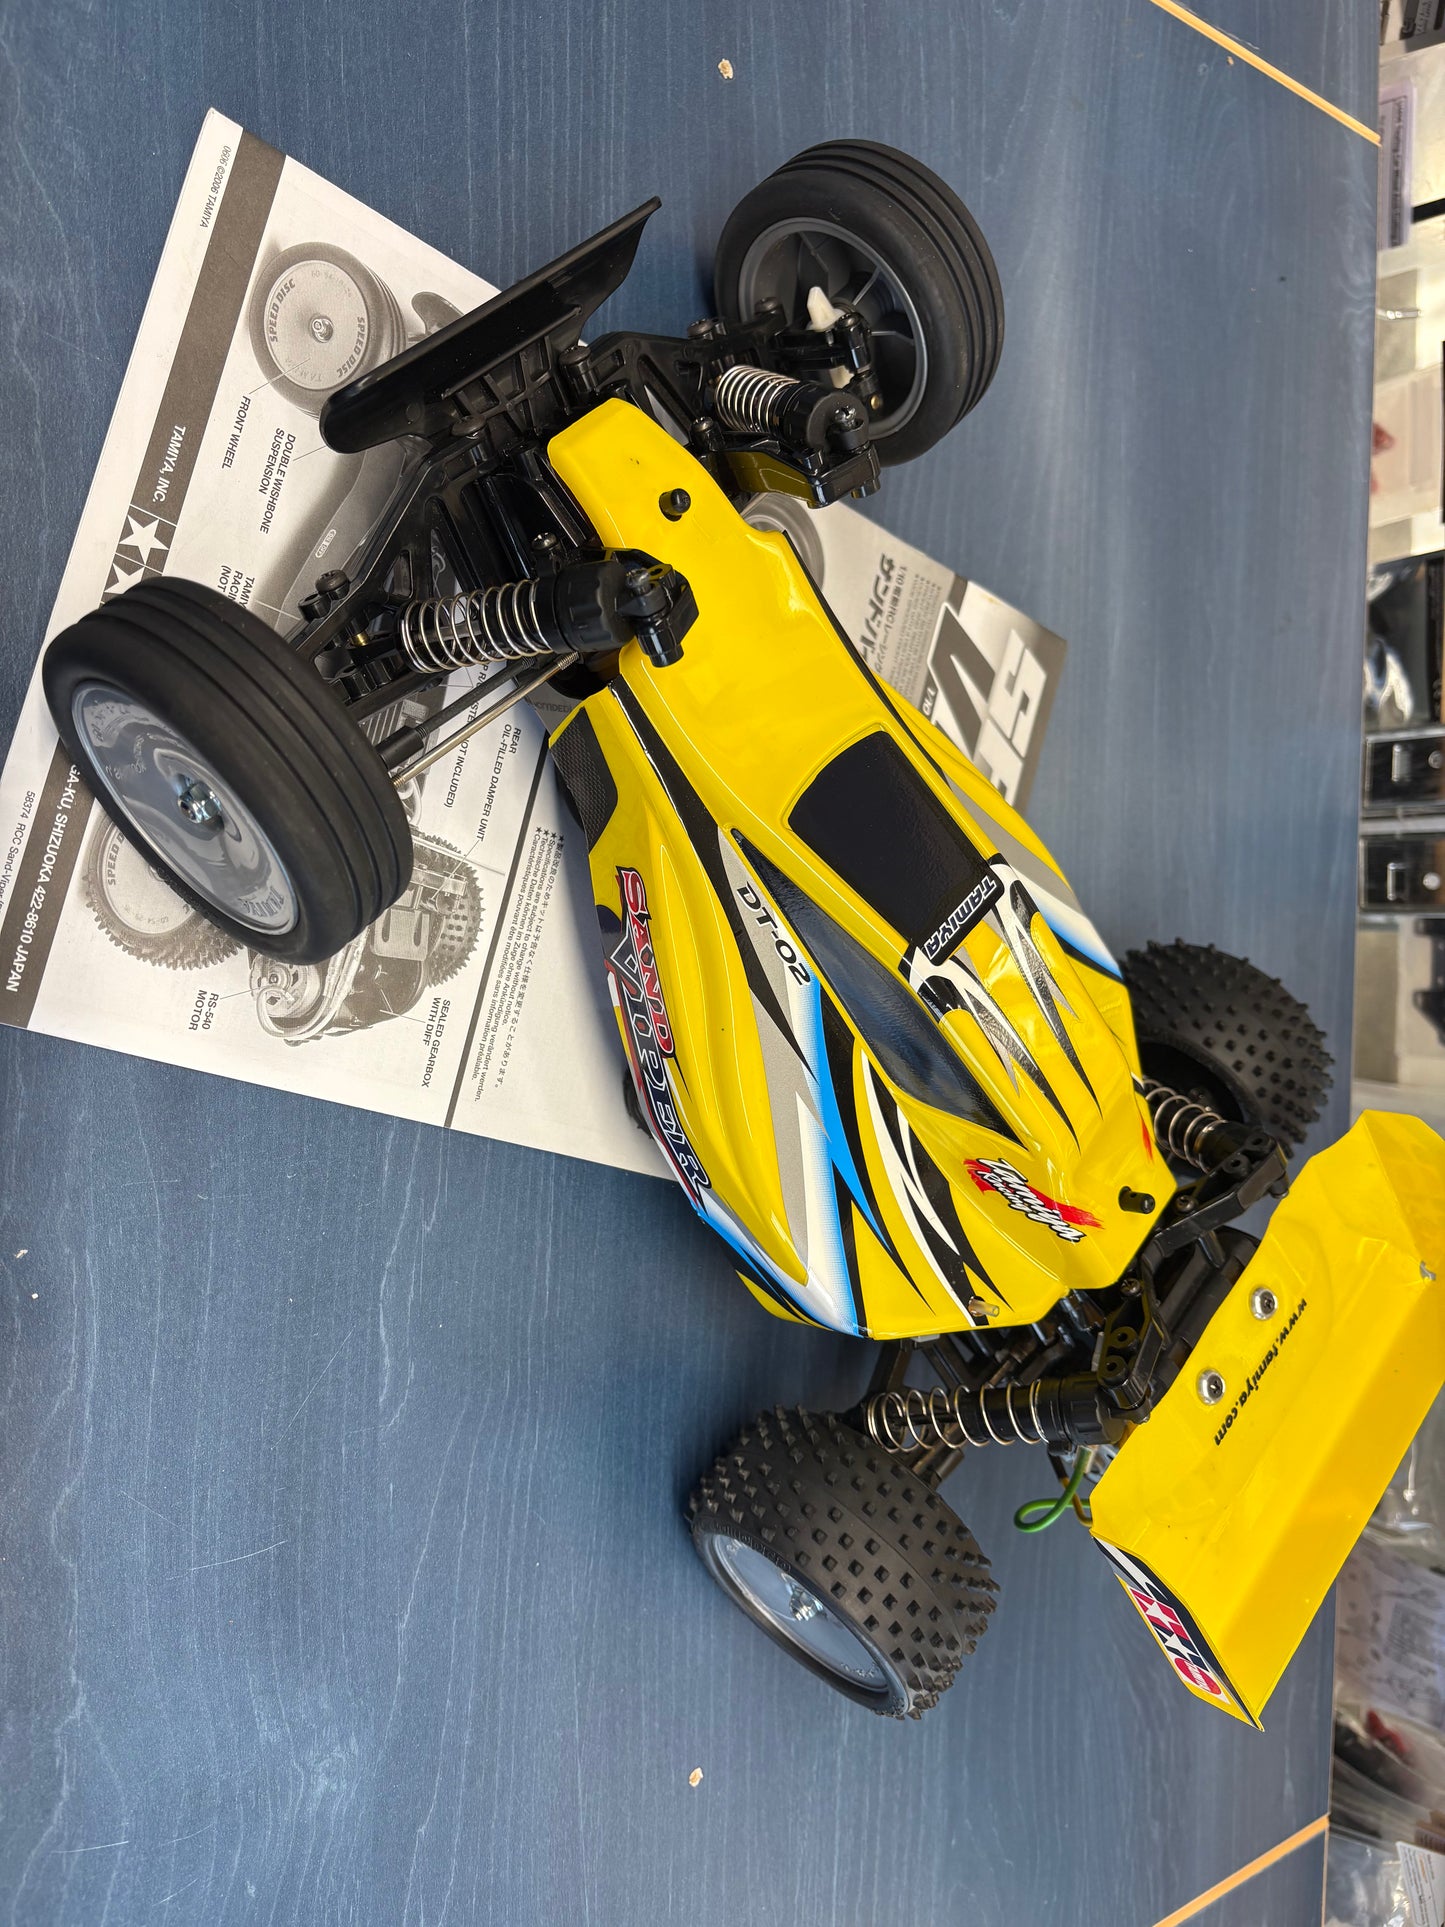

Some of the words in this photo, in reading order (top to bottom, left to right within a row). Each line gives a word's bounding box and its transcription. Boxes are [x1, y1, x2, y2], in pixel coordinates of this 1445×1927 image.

[219, 145, 231, 166] 0606
[200, 195, 217, 227] TAMIYA
[269, 303, 280, 343] SPEED
[278, 278, 297, 305] DISC
[353, 316, 366, 354] SPEED
[336, 354, 358, 378] DISC
[233, 395, 251, 433] FRONT
[159, 425, 186, 474] TAMIYA,
[222, 434, 240, 469] WHEEL
[258, 428, 285, 495] SUSPENSION
[276, 433, 296, 477] DOUBLE
[152, 476, 170, 502] INC.
[260, 478, 283, 534] WISHBONE
[217, 565, 231, 592] (NOT
[237, 575, 255, 609] TAMIY
[493, 724, 512, 774] OIL-FILLED
[509, 727, 522, 754] REAR
[444, 756, 465, 808] INCLUDED)
[482, 775, 499, 817] DAMPER
[20, 790, 35, 819] 58374
[12, 822, 26, 845] RCC
[37, 813, 68, 882] SHIZUOKA
[476, 818, 488, 841] UNIT
[107, 845, 120, 886] SPEED
[520, 833, 540, 893] Caractéristiques
[532, 837, 548, 878] Technische
[536, 838, 556, 890] Specifications
[526, 878, 537, 901] Daten
[20, 885, 46, 944] 422-8610
[512, 893, 524, 925] pouvant
[519, 902, 531, 930] können
[526, 904, 538, 932] subject
[922, 875, 997, 960] TAMIYA
[507, 926, 517, 941] être
[507, 941, 520, 961] Zuge
[515, 931, 523, 941] im
[524, 933, 531, 941] to
[736, 881, 813, 985] DT-02
[6, 944, 28, 992] JAPAN
[505, 962, 514, 982] ohne
[516, 942, 527, 970] change
[619, 867, 676, 1056] SAND
[492, 979, 501, 998] sans
[509, 972, 520, 999] without
[188, 990, 207, 1030] MOTOR
[202, 993, 219, 1030] RS-540
[428, 997, 441, 1022] WITH
[435, 999, 450, 1037] SEALED
[481, 999, 497, 1042] information
[491, 982, 509, 1033] Ankündigung
[502, 1000, 512, 1025] notice.
[423, 1024, 434, 1046] DIFF
[482, 1034, 496, 1070] verändert
[609, 911, 711, 1190] VIPER
[421, 1039, 440, 1088] GEARBOX
[471, 1043, 485, 1080] préalable.
[474, 1072, 486, 1102] werden.
[975, 1169, 1034, 1213] Racing
[975, 1157, 1087, 1243] Tamiya
[1209, 1296, 1309, 1447] www.tamiya.com
